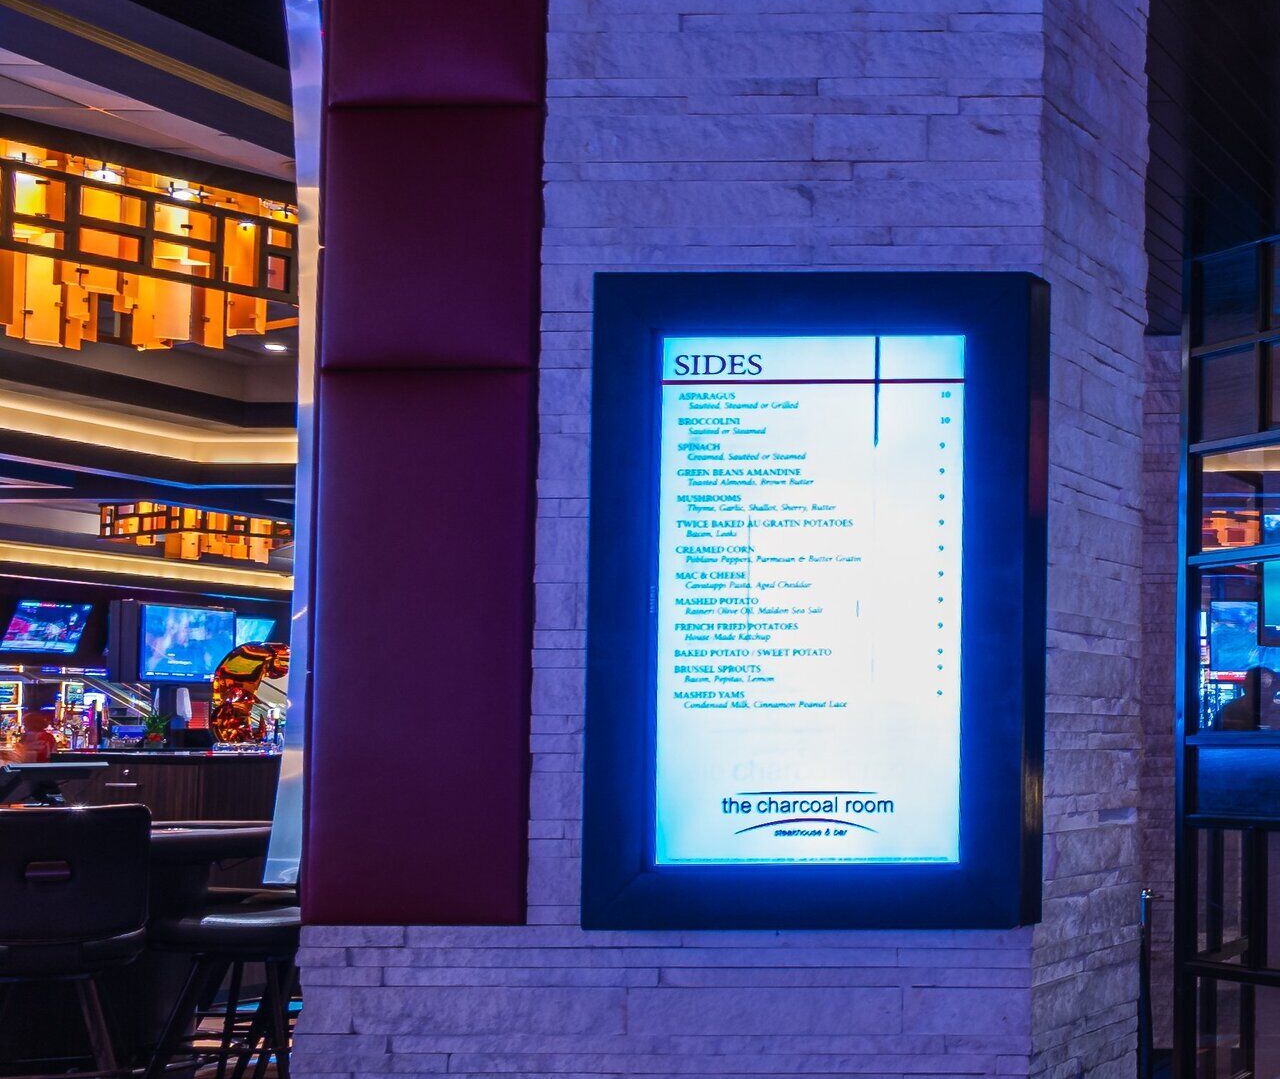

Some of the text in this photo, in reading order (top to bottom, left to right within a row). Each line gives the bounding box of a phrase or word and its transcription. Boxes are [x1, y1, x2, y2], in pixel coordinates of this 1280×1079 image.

[674, 354, 762, 376] SIDES
[678, 392, 736, 400] ASPARAGUS
[724, 401, 758, 410] Steamed
[760, 401, 768, 410] or
[771, 401, 799, 410] Grilled
[678, 417, 740, 426] BROCCOLINI
[722, 427, 730, 435] or
[733, 427, 766, 435] Steamed
[677, 443, 720, 451] SPINACH
[762, 452, 770, 461] or
[773, 452, 806, 461] Steamed
[677, 469, 801, 477] GREEN BEANS AMANDINE
[688, 478, 717, 486] Toasted
[760, 478, 786, 486] Brown
[789, 478, 814, 486] Butter
[677, 494, 742, 502] MUSHROOMS
[811, 504, 837, 512] Butter
[676, 520, 854, 528] TWICE BAKED AU GRATIN POTATOES
[716, 530, 737, 538] Leeks
[675, 546, 755, 554] CREAMED CORN
[686, 556, 718, 564] Poblano
[756, 556, 796, 564] Parmesan
[808, 556, 832, 564] Butter
[835, 556, 861, 564] Gratin
[675, 572, 746, 580] MAC & CHEESE
[756, 581, 775, 589] Aged
[778, 581, 812, 589] Cheddar
[717, 607, 737, 615] Olive
[758, 607, 788, 615] Maldon
[792, 607, 805, 615] Sea
[808, 607, 822, 615] Salt
[675, 622, 799, 631] FRENCH FRIED POTATOES
[738, 633, 770, 642] Ketchup
[674, 648, 707, 657] BAKED
[710, 648, 749, 657] POTATO
[757, 648, 789, 657] SWEET
[793, 648, 832, 657] POTATO
[674, 664, 761, 673] BRUSSEL SPROUTS
[747, 675, 774, 683] Lemon
[674, 691, 744, 699] MASHED YAMS
[684, 700, 727, 709] Condensed
[753, 700, 796, 709] Cinnamon
[799, 700, 826, 709] Peanut
[721, 796, 894, 814] the charcoal room
[774, 828, 822, 837] steakhouse
[834, 828, 847, 837] bar
